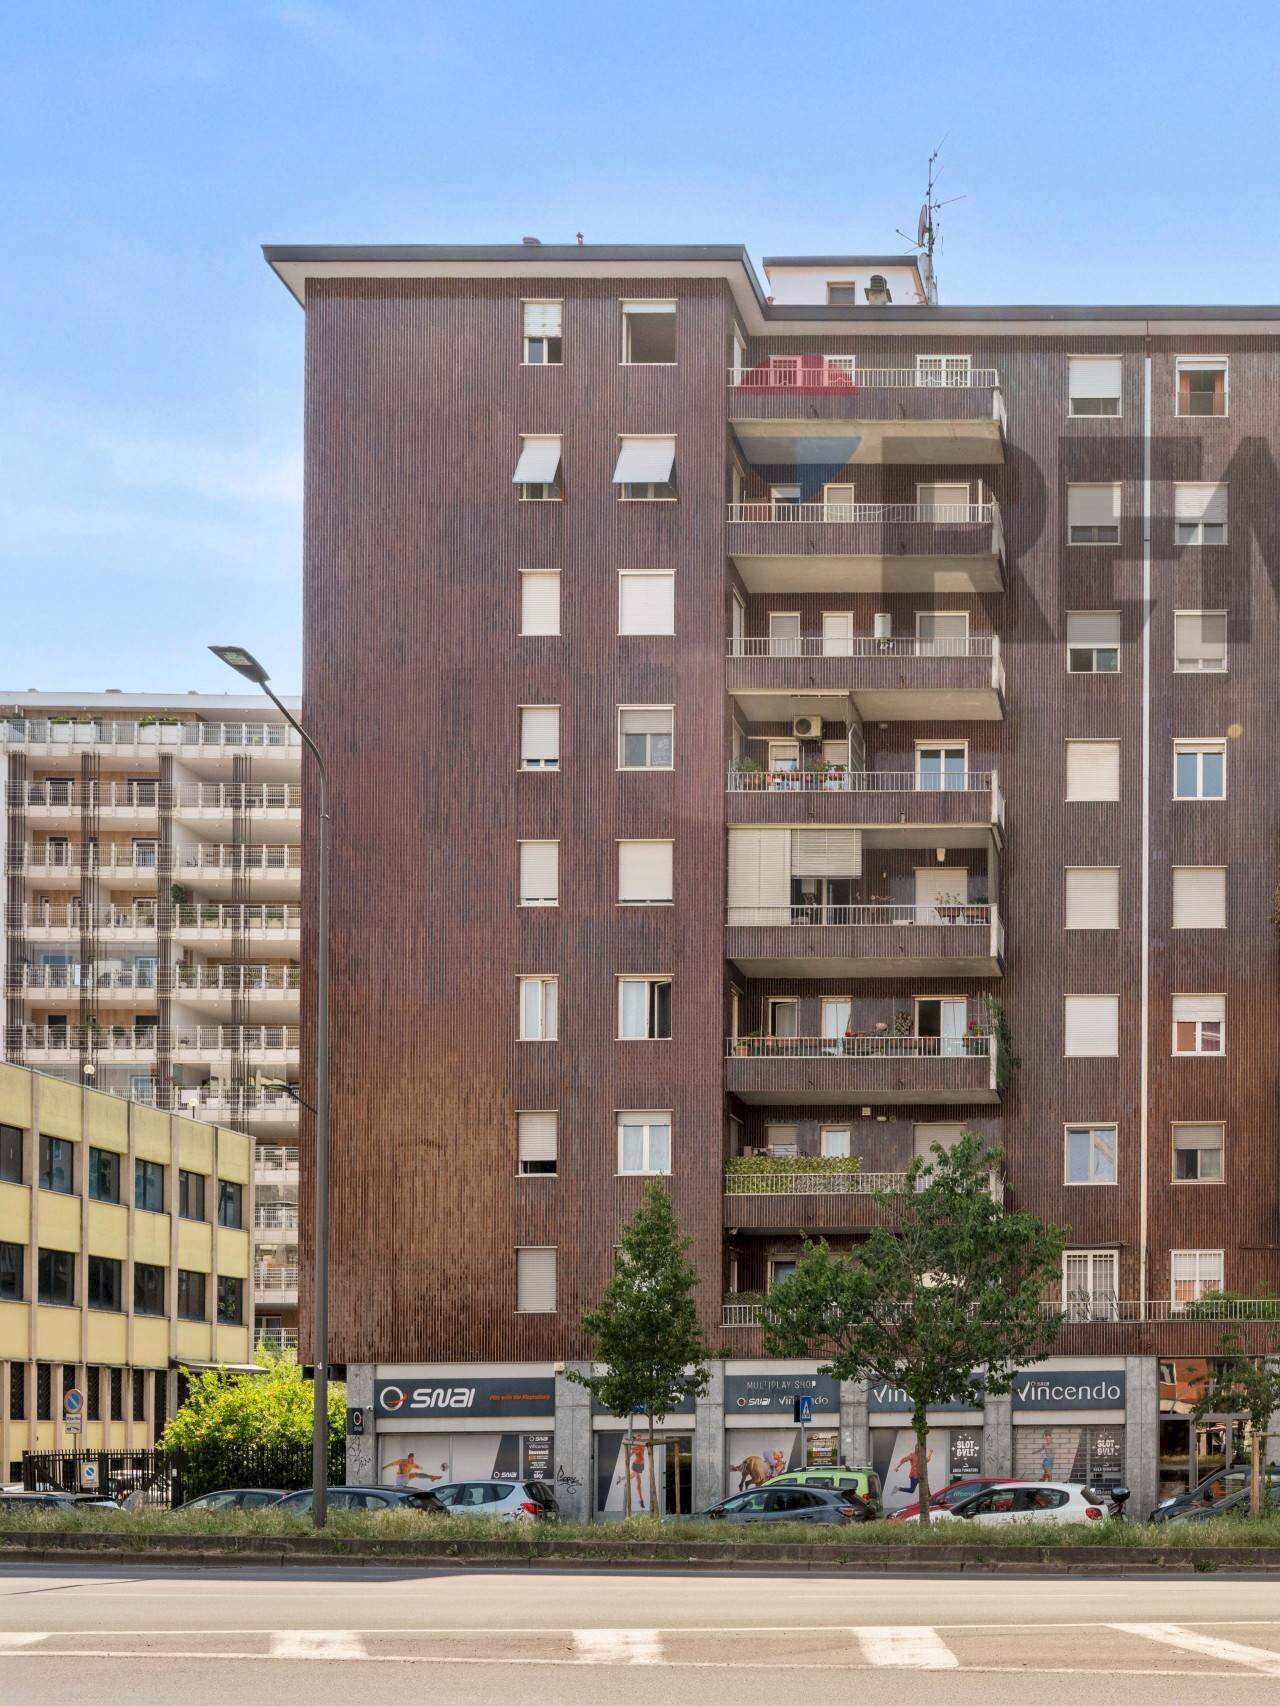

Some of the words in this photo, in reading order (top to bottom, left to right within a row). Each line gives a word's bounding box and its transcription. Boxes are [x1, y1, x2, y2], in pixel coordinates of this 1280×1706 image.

[746, 1380, 791, 1390] MULTIPLAY
[794, 1380, 817, 1390] SHOP
[1017, 1381, 1121, 1401] Vincendo
[778, 1395, 829, 1406] Vindo
[956, 1440, 975, 1449] SLOT
[1097, 1440, 1115, 1448] SLOT
